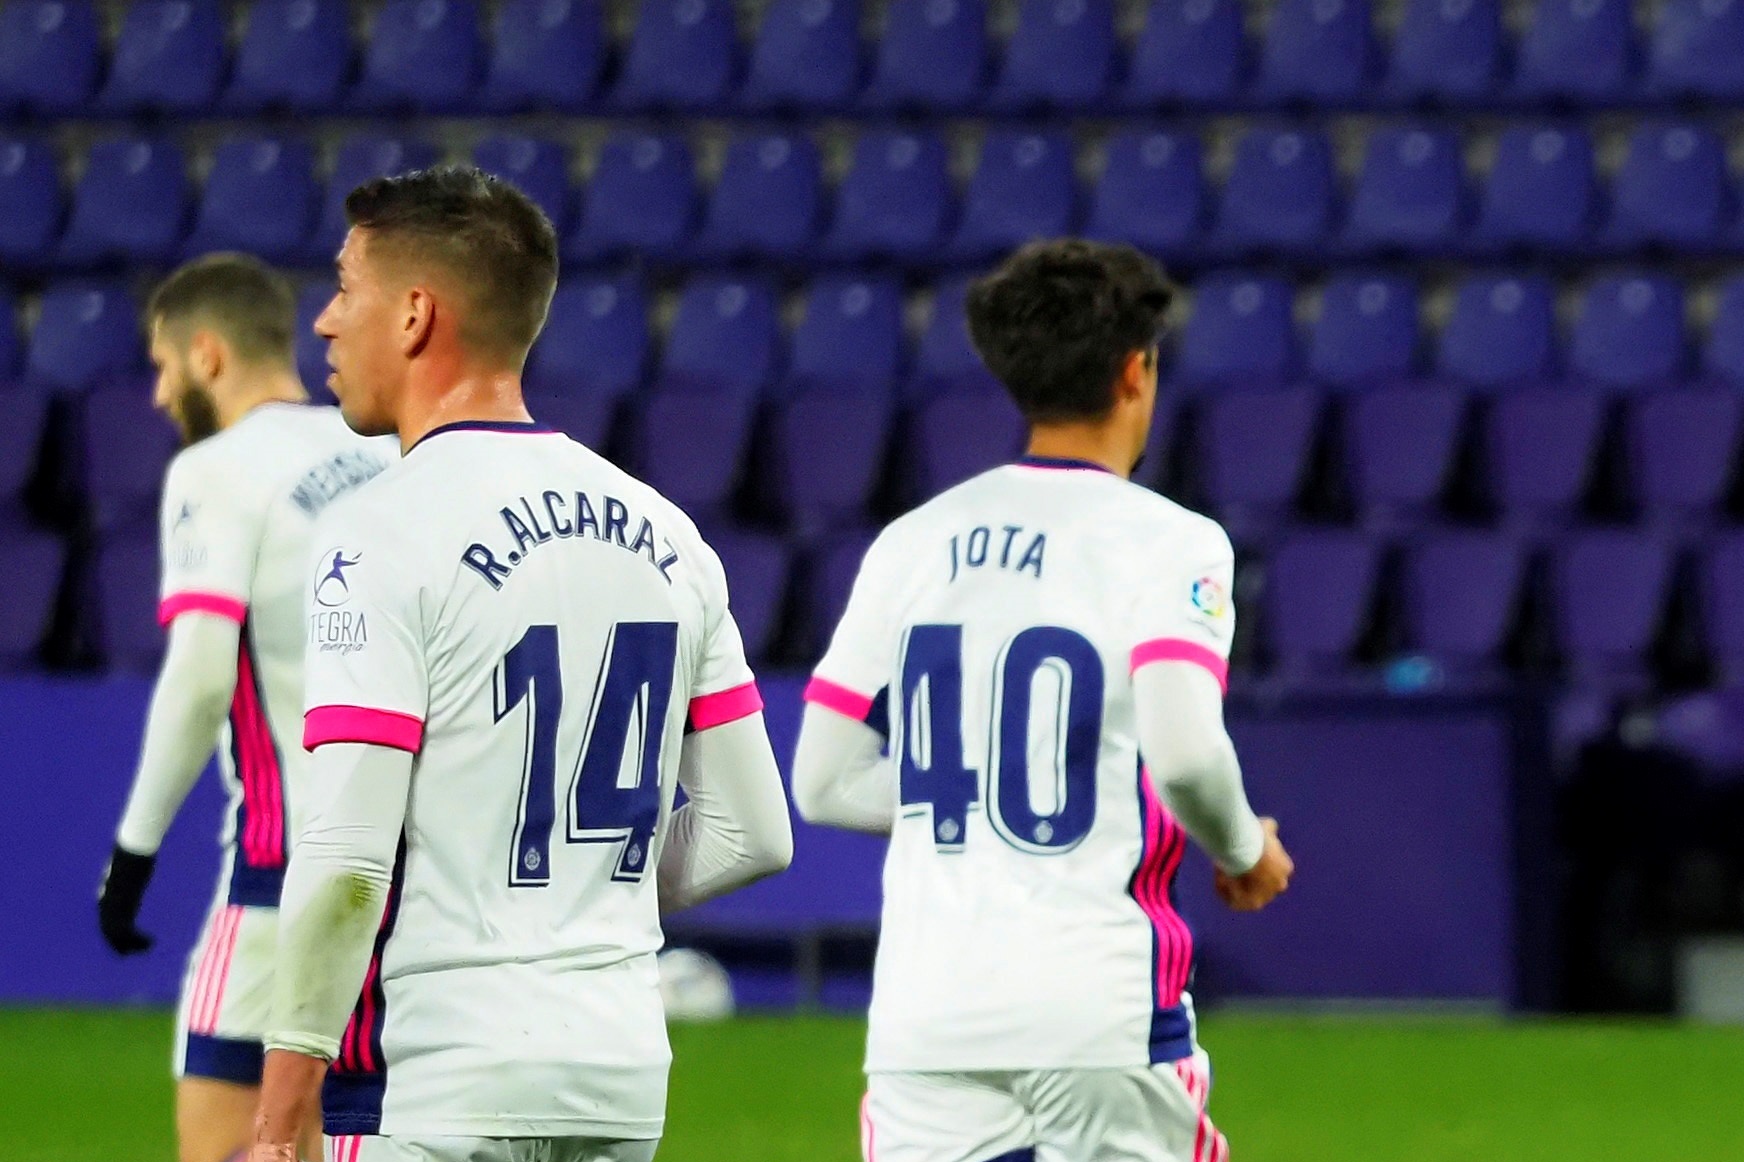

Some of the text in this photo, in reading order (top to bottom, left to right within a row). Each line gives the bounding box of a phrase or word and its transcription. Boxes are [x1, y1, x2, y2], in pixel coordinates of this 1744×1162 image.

[460, 490, 680, 592] R.ALCARAZ
[948, 525, 1049, 583] JOTA
[492, 621, 680, 889] 14
[897, 623, 1106, 856] 40
